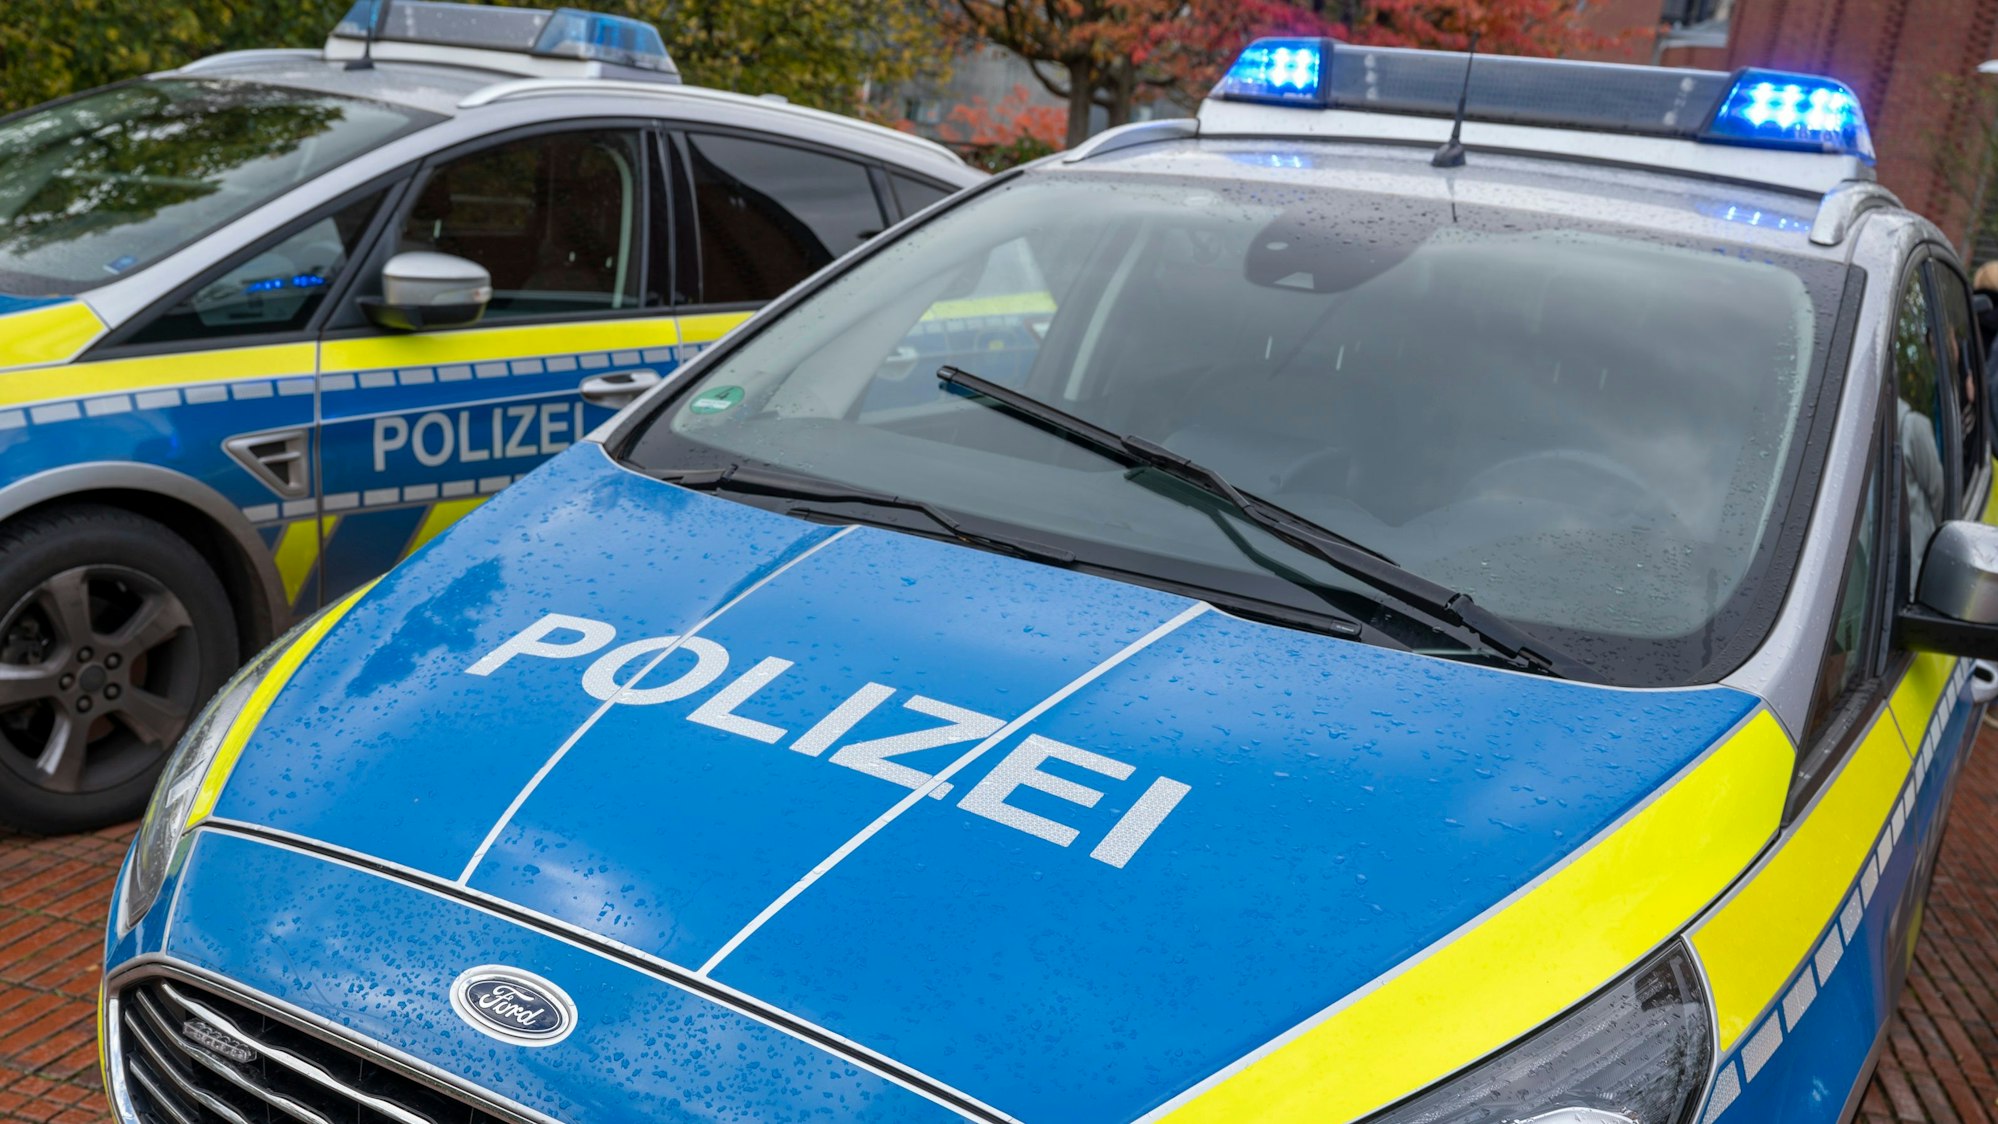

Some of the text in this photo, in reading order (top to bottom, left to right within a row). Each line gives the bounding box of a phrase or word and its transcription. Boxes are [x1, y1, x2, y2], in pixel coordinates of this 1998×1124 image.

[714, 386, 735, 400] 4
[373, 402, 584, 472] POLIZEI
[464, 612, 1193, 869] POLIZEI
[479, 985, 545, 1026] Ford
